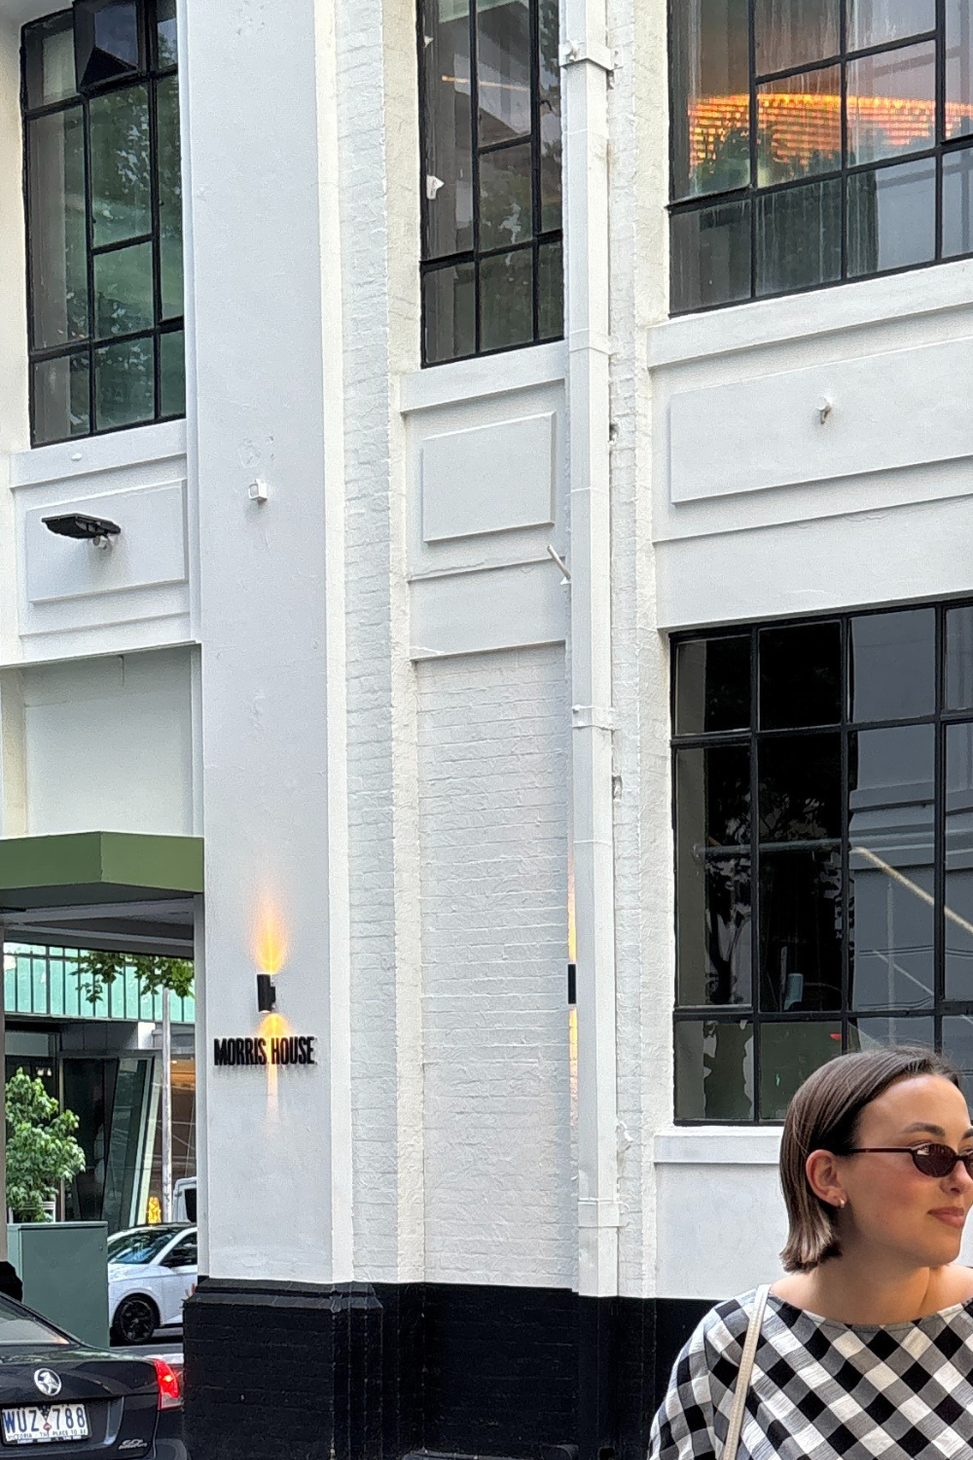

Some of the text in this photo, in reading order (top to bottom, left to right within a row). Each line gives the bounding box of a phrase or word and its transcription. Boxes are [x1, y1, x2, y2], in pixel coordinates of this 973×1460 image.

[213, 1036, 316, 1066] MORRIS HOUSE
[3, 1406, 86, 1433] WUZ 788
